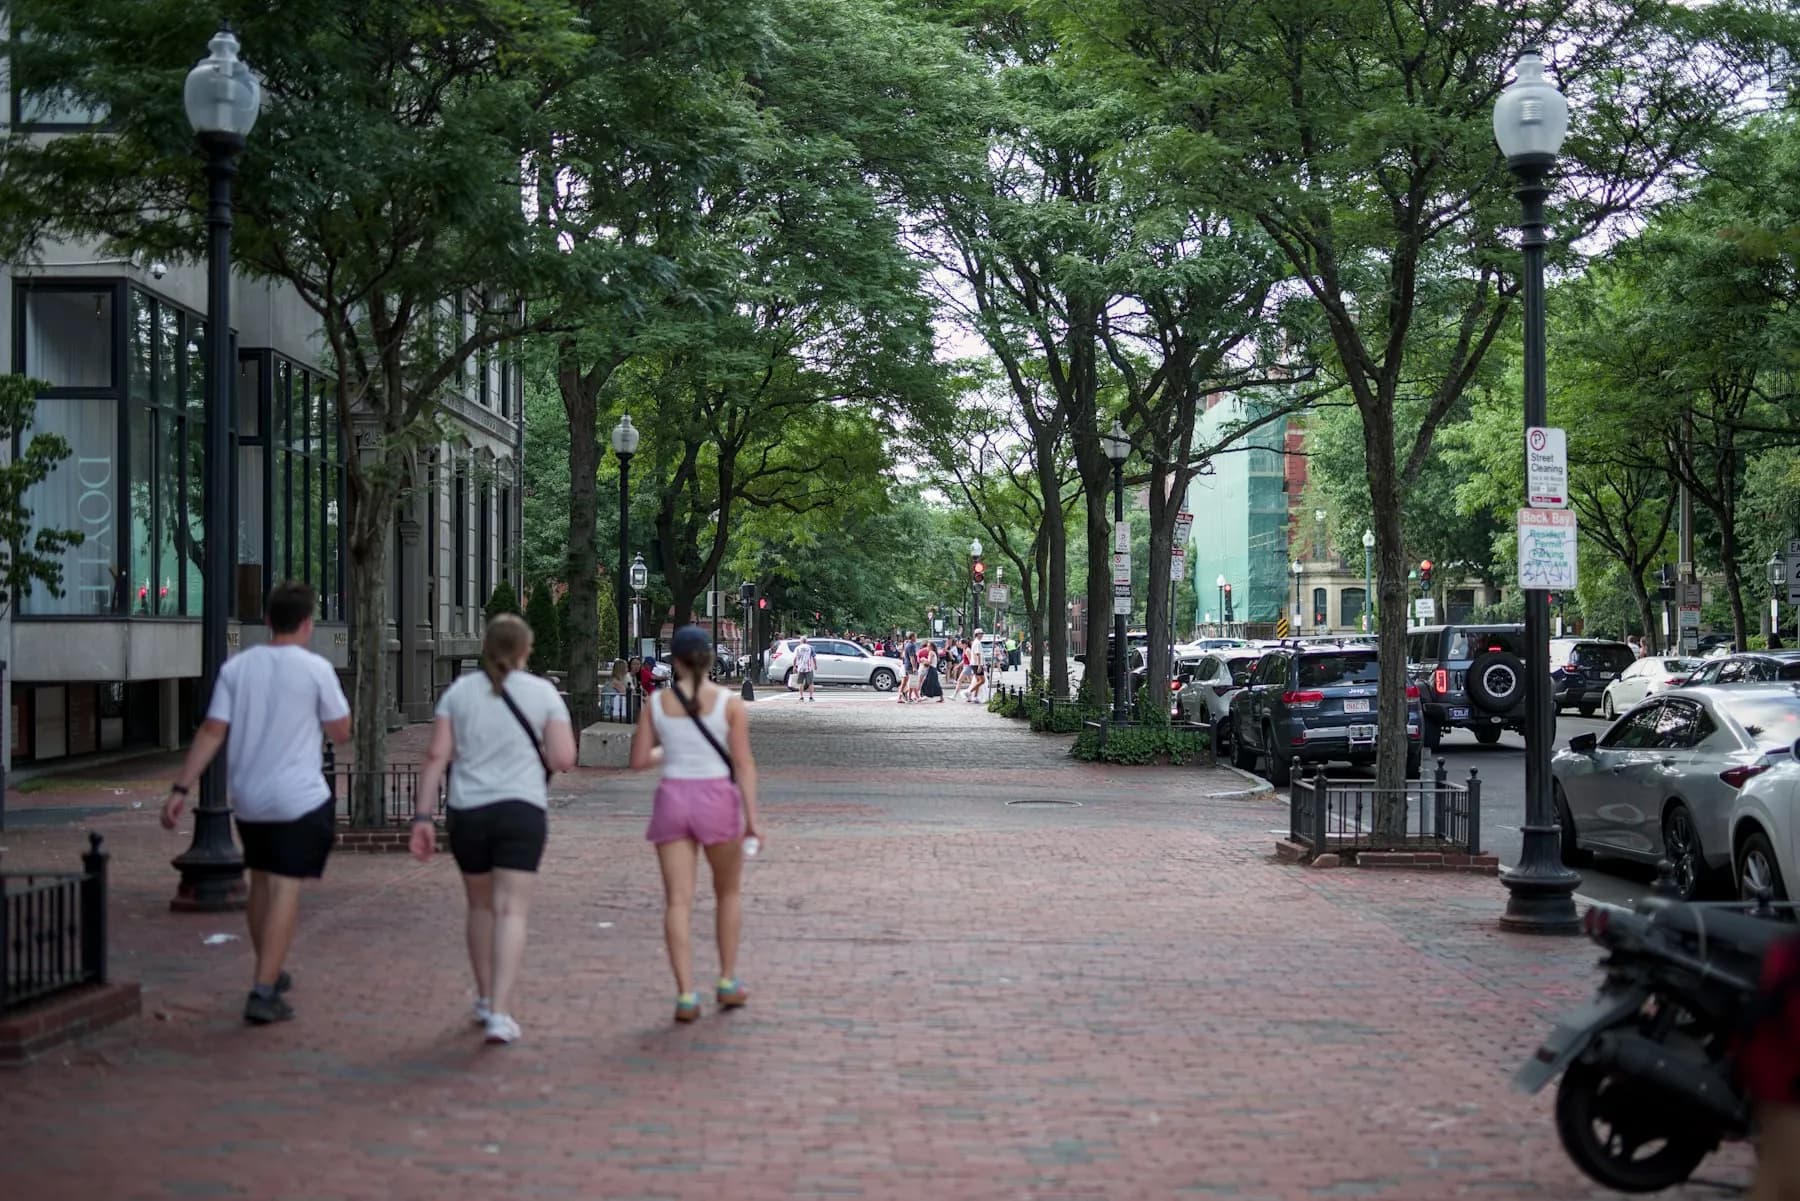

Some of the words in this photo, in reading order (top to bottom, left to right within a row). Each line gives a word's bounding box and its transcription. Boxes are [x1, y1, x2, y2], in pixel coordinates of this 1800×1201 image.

[1531, 453, 1554, 463] Street
[1531, 463, 1563, 475] Cleaning
[1523, 511, 1547, 524] Back
[1551, 512, 1569, 526] Bay
[1530, 529, 1566, 538] Resident
